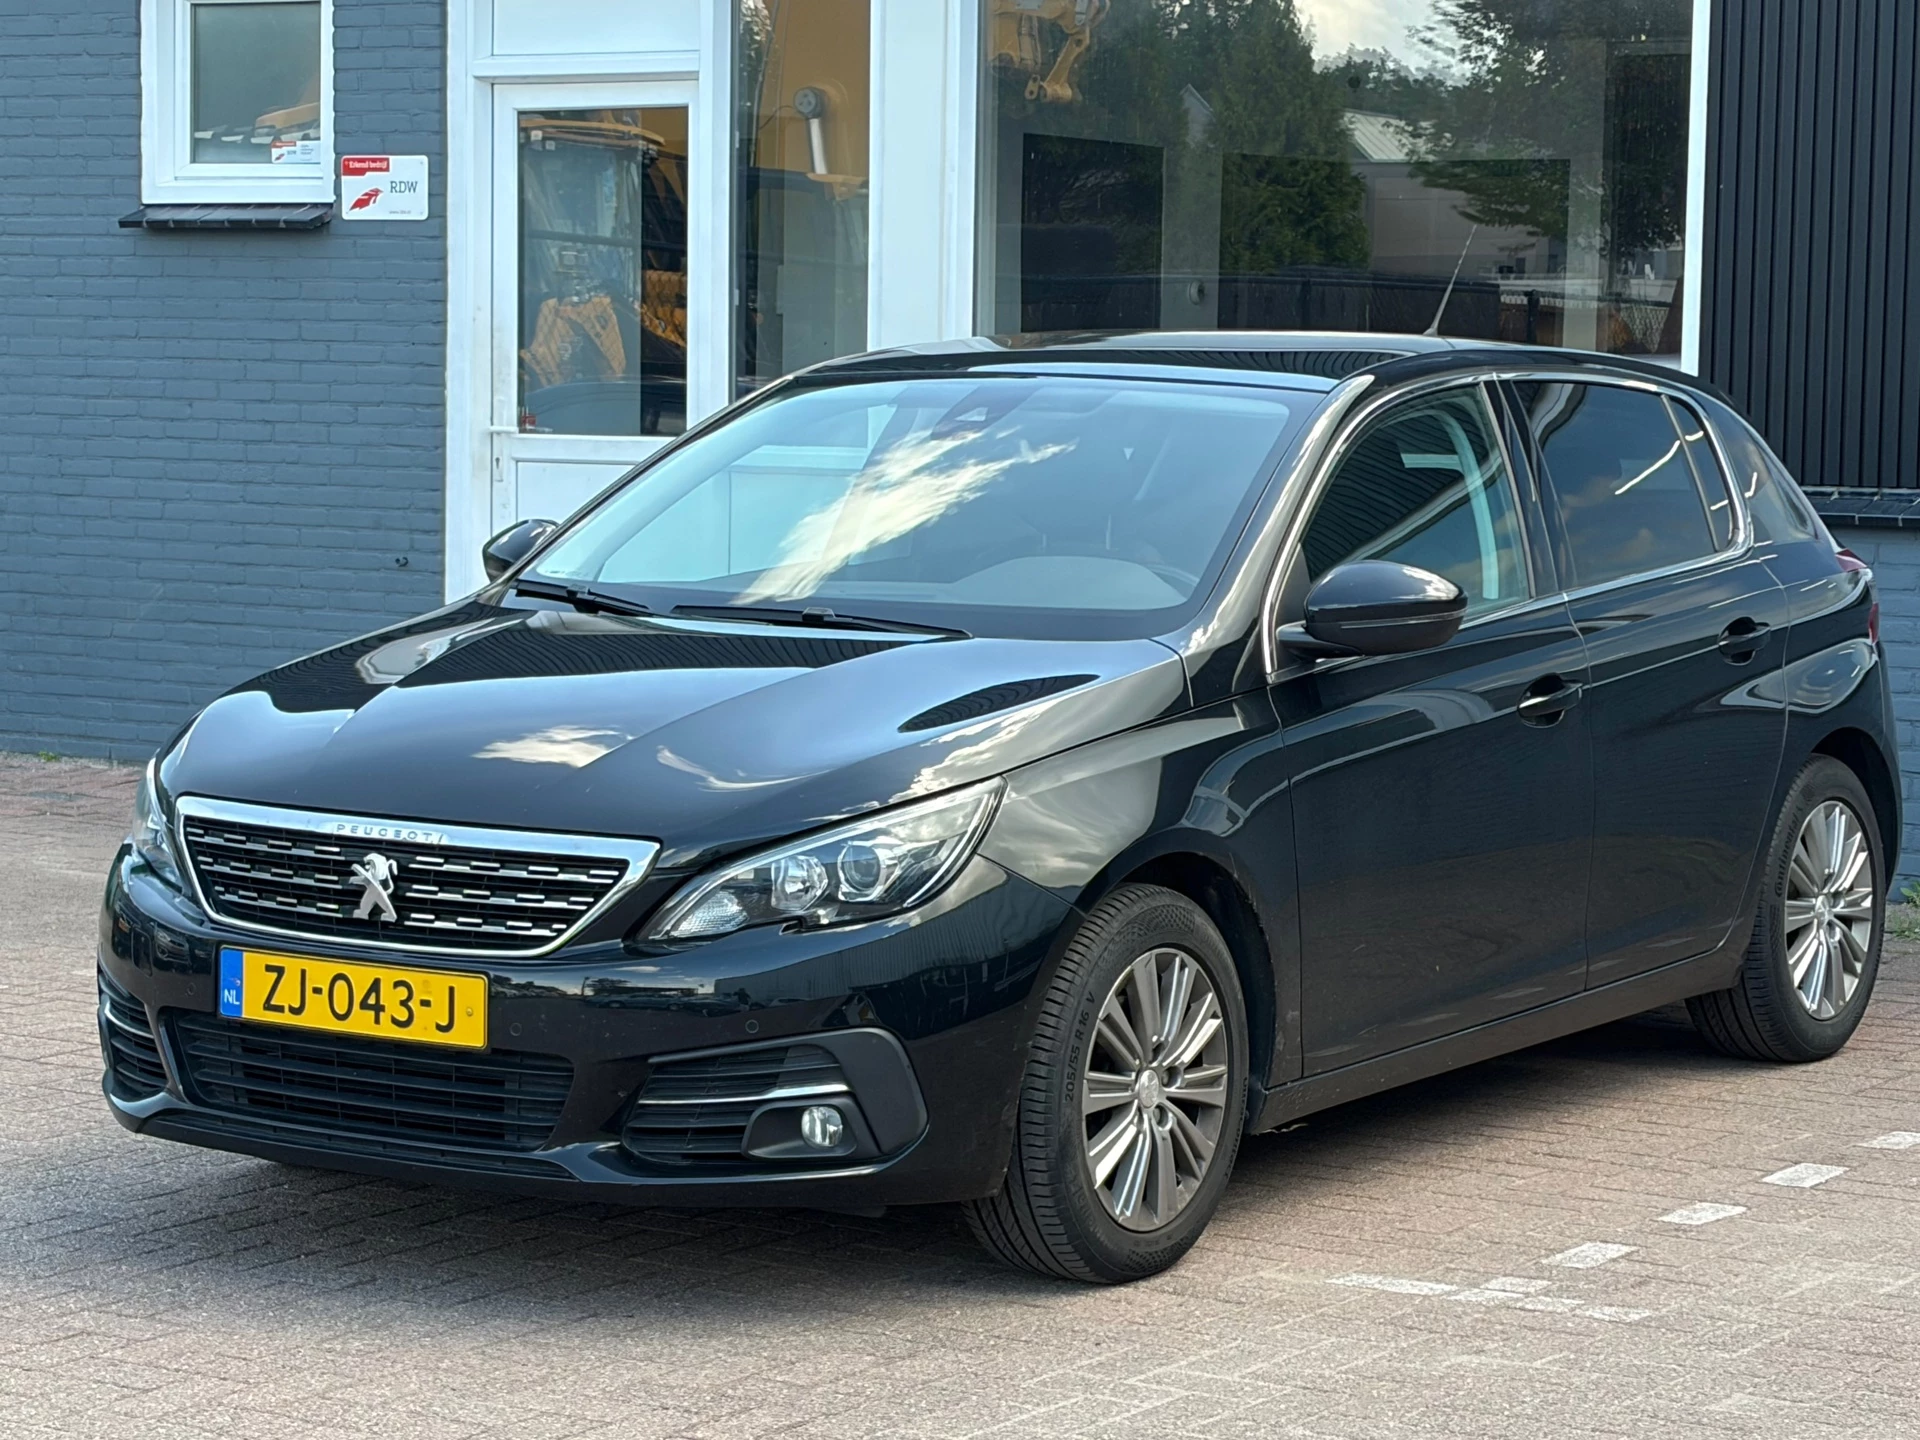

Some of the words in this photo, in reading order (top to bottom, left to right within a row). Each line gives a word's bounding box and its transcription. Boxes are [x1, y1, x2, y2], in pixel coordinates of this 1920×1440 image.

[389, 180, 418, 193] RDW
[336, 823, 433, 841] PEUGEOT
[223, 987, 240, 1006] NL
[262, 963, 456, 1034] ZJ-043-J
[1086, 990, 1096, 1006] V
[1078, 1011, 1090, 1028] 16
[1074, 1030, 1084, 1042] R
[1065, 1045, 1081, 1103] 205/55
